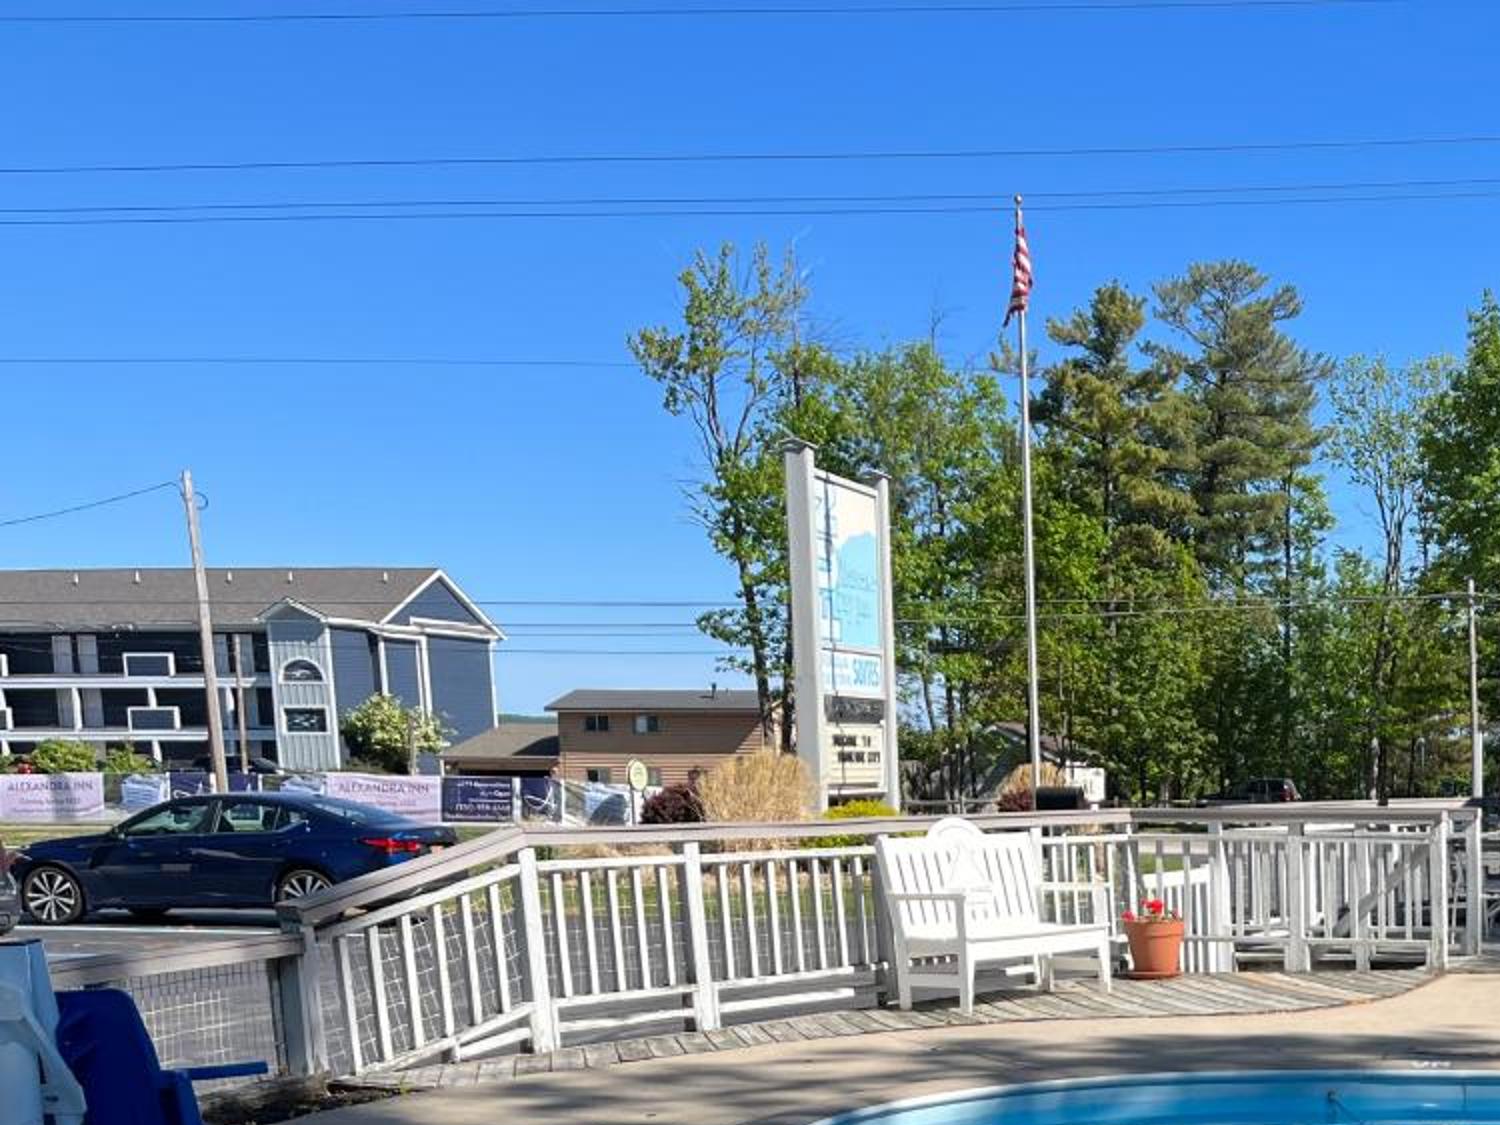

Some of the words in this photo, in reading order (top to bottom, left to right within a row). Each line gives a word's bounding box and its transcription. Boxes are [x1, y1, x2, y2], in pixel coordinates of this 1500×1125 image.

[7, 780, 71, 791] ALEXANDRA
[73, 780, 93, 791] INN
[338, 782, 405, 793] ALEXANDRA
[408, 783, 429, 793] INN
